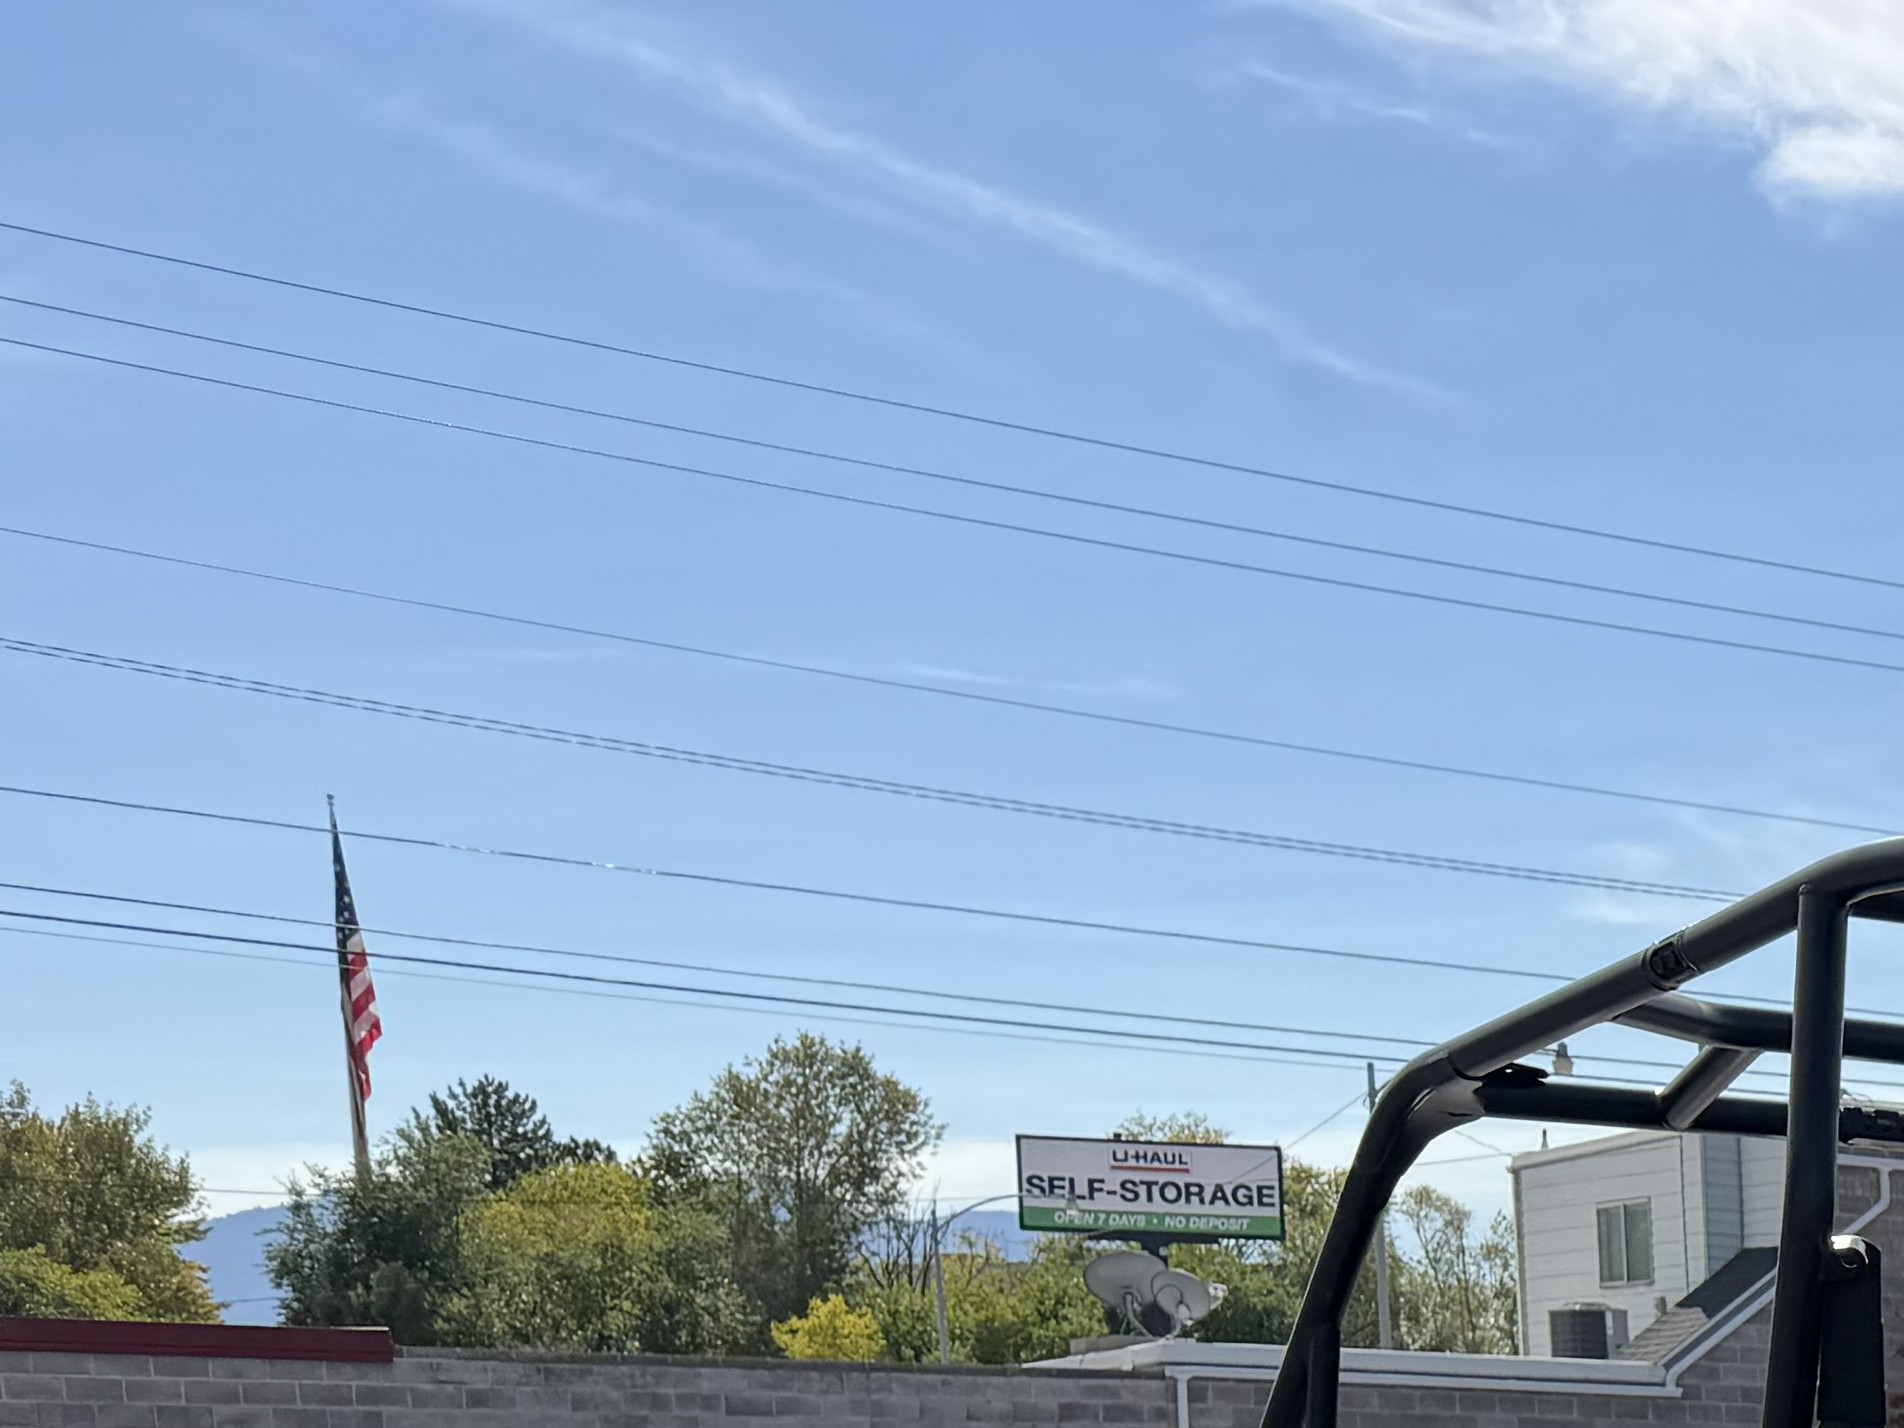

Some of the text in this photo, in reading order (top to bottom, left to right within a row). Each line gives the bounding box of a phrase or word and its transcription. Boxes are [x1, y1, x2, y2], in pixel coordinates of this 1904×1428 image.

[1112, 1149, 1188, 1166] U-HAUL
[1025, 1175, 1275, 1207] SELF-STORAGE
[1108, 1213, 1146, 1228] DAYS
[1164, 1215, 1187, 1231] NO
[1188, 1217, 1252, 1232] DEPOSIT
